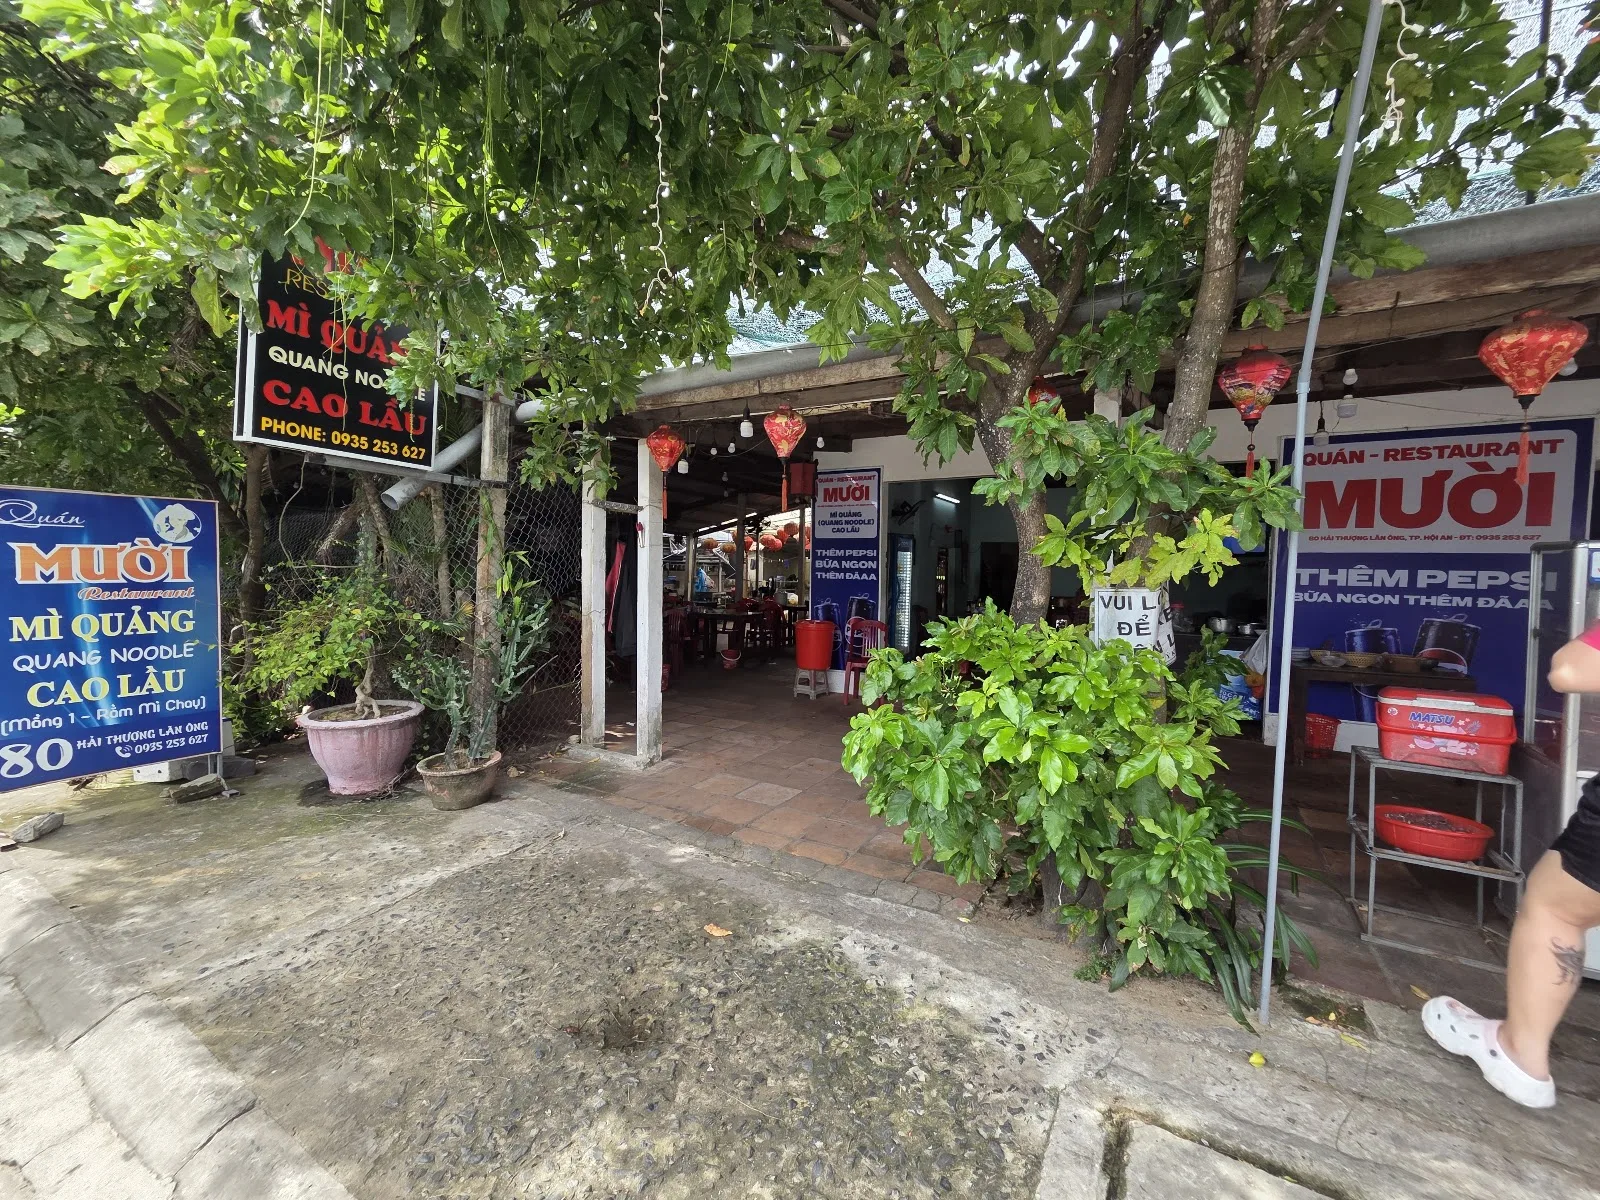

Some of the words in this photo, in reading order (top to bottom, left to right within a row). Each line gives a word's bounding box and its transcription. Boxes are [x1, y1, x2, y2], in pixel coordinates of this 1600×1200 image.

[266, 300, 312, 338] MÌ
[268, 346, 349, 380] QUANG
[262, 380, 349, 418] CAO
[261, 416, 326, 442] PHONE:
[331, 430, 369, 450] 0935
[373, 440, 398, 456] 253
[402, 445, 426, 460] 627
[1303, 448, 1365, 466] QUÁN
[1384, 439, 1564, 462] RESTAURANT
[823, 483, 870, 503] MƯỜI
[1303, 461, 1555, 531] MƯỜI
[0, 499, 86, 528] Quán
[844, 518, 874, 526] NOODLE)
[7, 538, 194, 584] MƯỜI
[815, 548, 844, 557] THÊM
[815, 559, 840, 568] BỮA
[842, 560, 877, 569] NGON
[815, 571, 844, 580] THÊM
[1296, 565, 1408, 588] THÊM
[1416, 569, 1557, 591] PEPSI
[77, 586, 195, 601] Restaurant
[1100, 596, 1132, 610] VUI
[1294, 590, 1333, 603] BỮA
[1336, 593, 1399, 605] NGON
[1404, 594, 1472, 607] THÊM
[9, 608, 63, 642] MÌ
[71, 605, 195, 642] QUẢNG
[1117, 614, 1151, 636] ĐỂ
[13, 650, 102, 673] QUANG
[110, 642, 194, 664] NOODLE
[26, 676, 110, 708] CAO
[69, 713, 75, 724] 1
[1409, 712, 1455, 725] MATSU
[107, 730, 155, 745] THƯỢNG
[134, 741, 163, 754] 0935
[166, 738, 185, 750] 253
[189, 734, 208, 746] 627
[0, 738, 73, 779] 80
